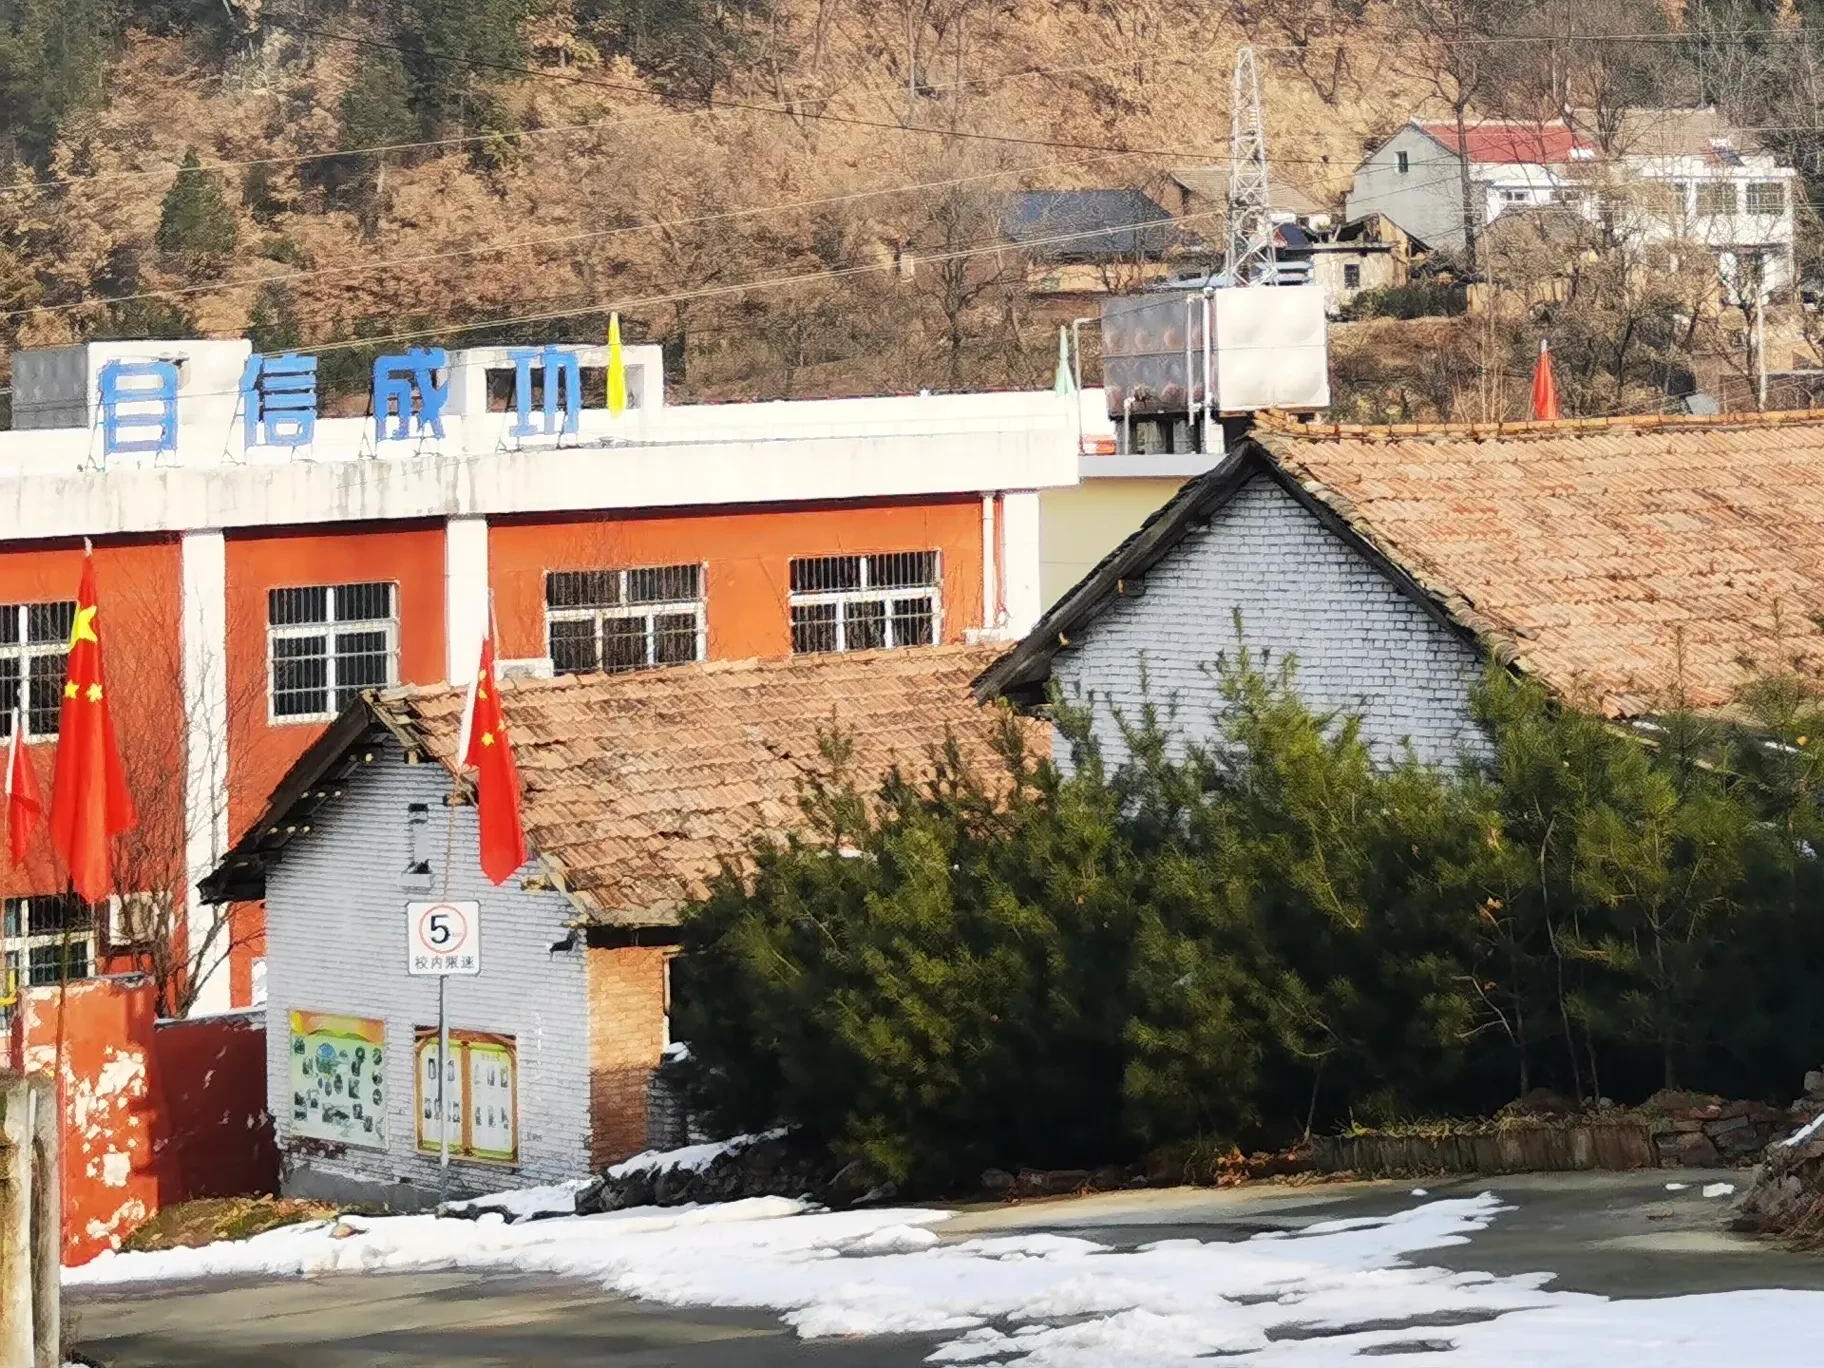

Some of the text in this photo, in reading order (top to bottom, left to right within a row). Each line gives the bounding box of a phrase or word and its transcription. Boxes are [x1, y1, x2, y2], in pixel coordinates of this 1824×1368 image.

[430, 914, 451, 944] 5
[415, 955, 475, 970] 校内限速
